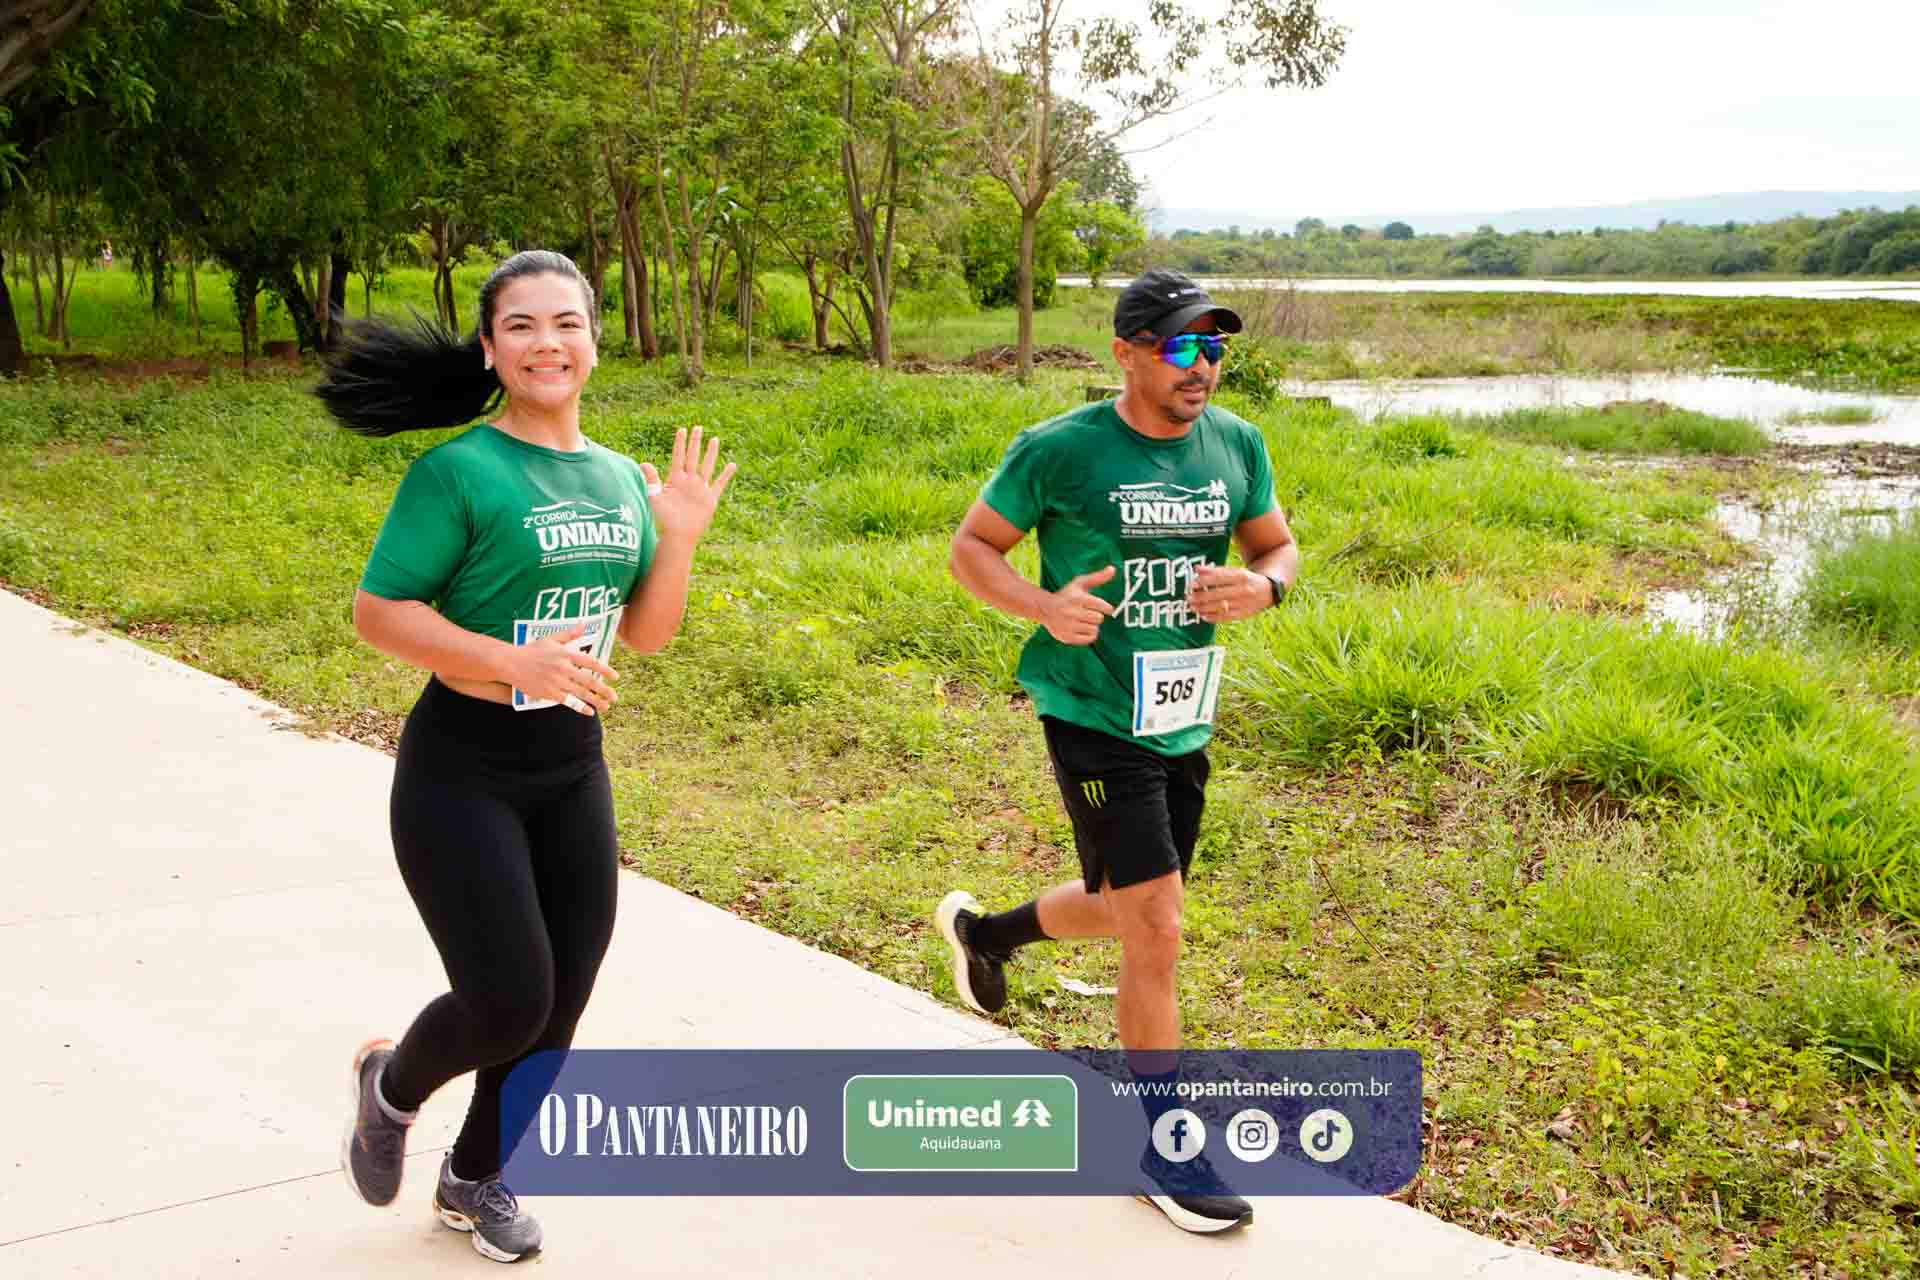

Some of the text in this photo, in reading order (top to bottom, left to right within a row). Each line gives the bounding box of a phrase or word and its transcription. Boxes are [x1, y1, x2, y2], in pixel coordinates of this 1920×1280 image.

[533, 509, 578, 526] CORRIDA
[1119, 499, 1231, 525] UNIMED
[536, 521, 640, 552] UNIMED
[1155, 677, 1196, 706] 508
